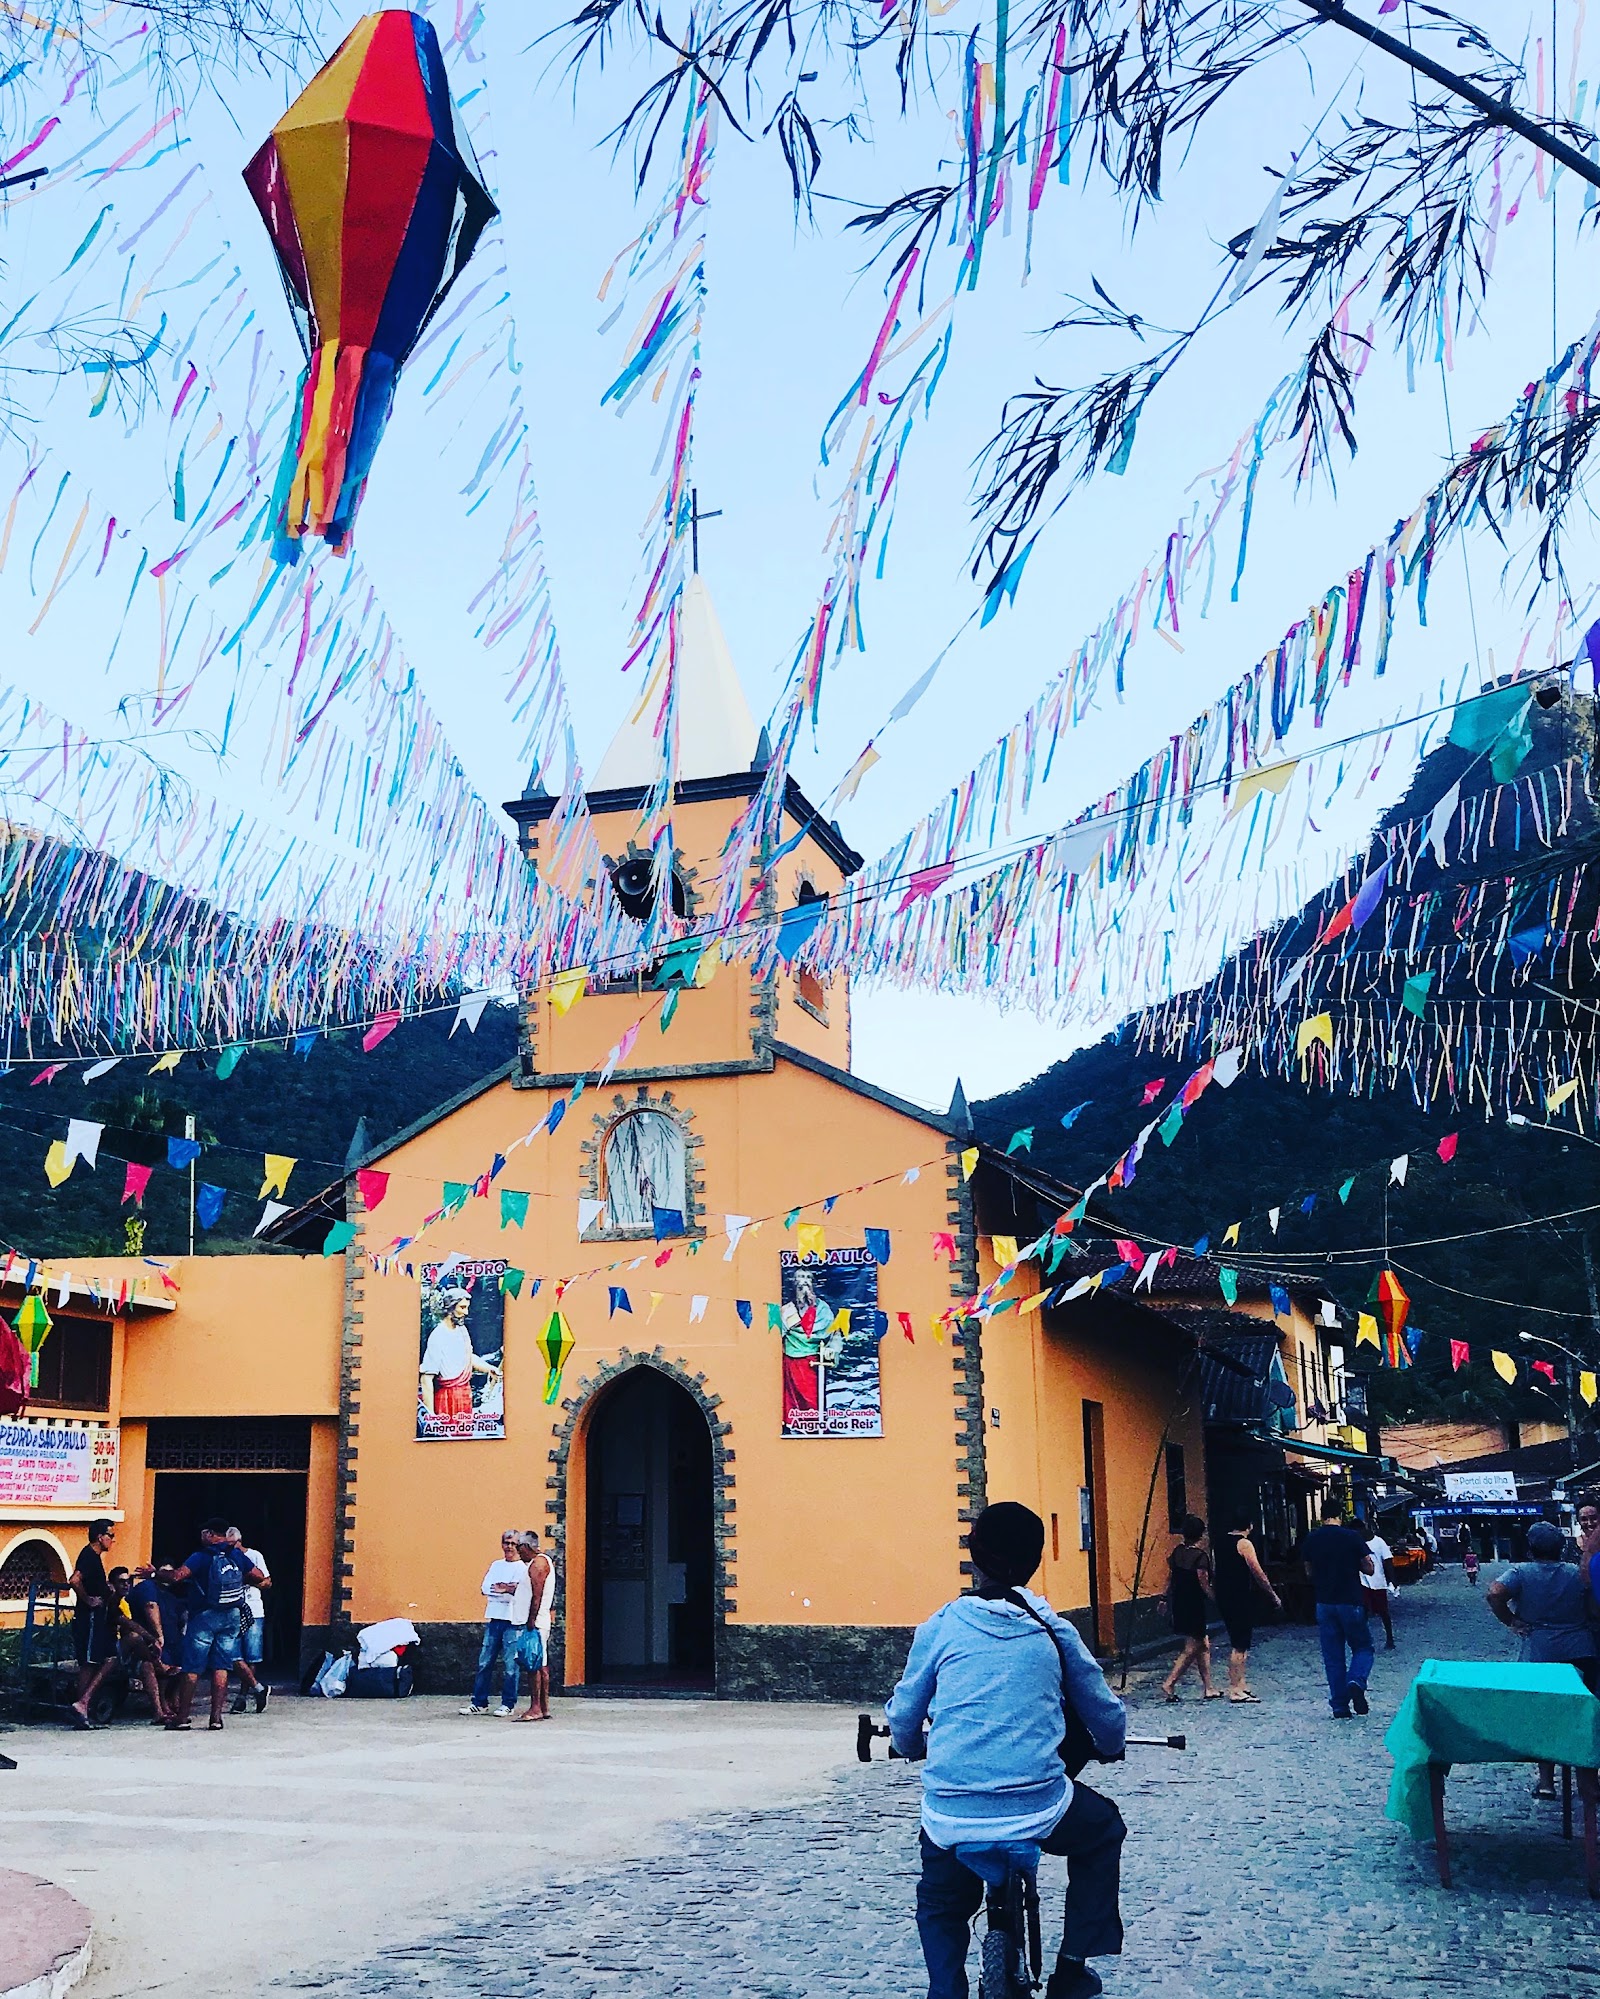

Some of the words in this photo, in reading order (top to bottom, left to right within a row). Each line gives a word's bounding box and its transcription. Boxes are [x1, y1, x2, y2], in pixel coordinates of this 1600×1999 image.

[819, 1249, 875, 1265] PAULO
[455, 1261, 507, 1277] PEDRO
[473, 1411, 500, 1420] Grande
[845, 1409, 876, 1417] Grande
[425, 1423, 456, 1434] Angra
[459, 1422, 475, 1432] dos
[477, 1420, 498, 1432] Reis
[791, 1420, 827, 1431] Angra
[829, 1419, 849, 1430] dos
[851, 1418, 875, 1430] Reis
[0, 1425, 32, 1447] PEDRO
[57, 1430, 87, 1450] PAULO
[1459, 1475, 1482, 1486] Portal
